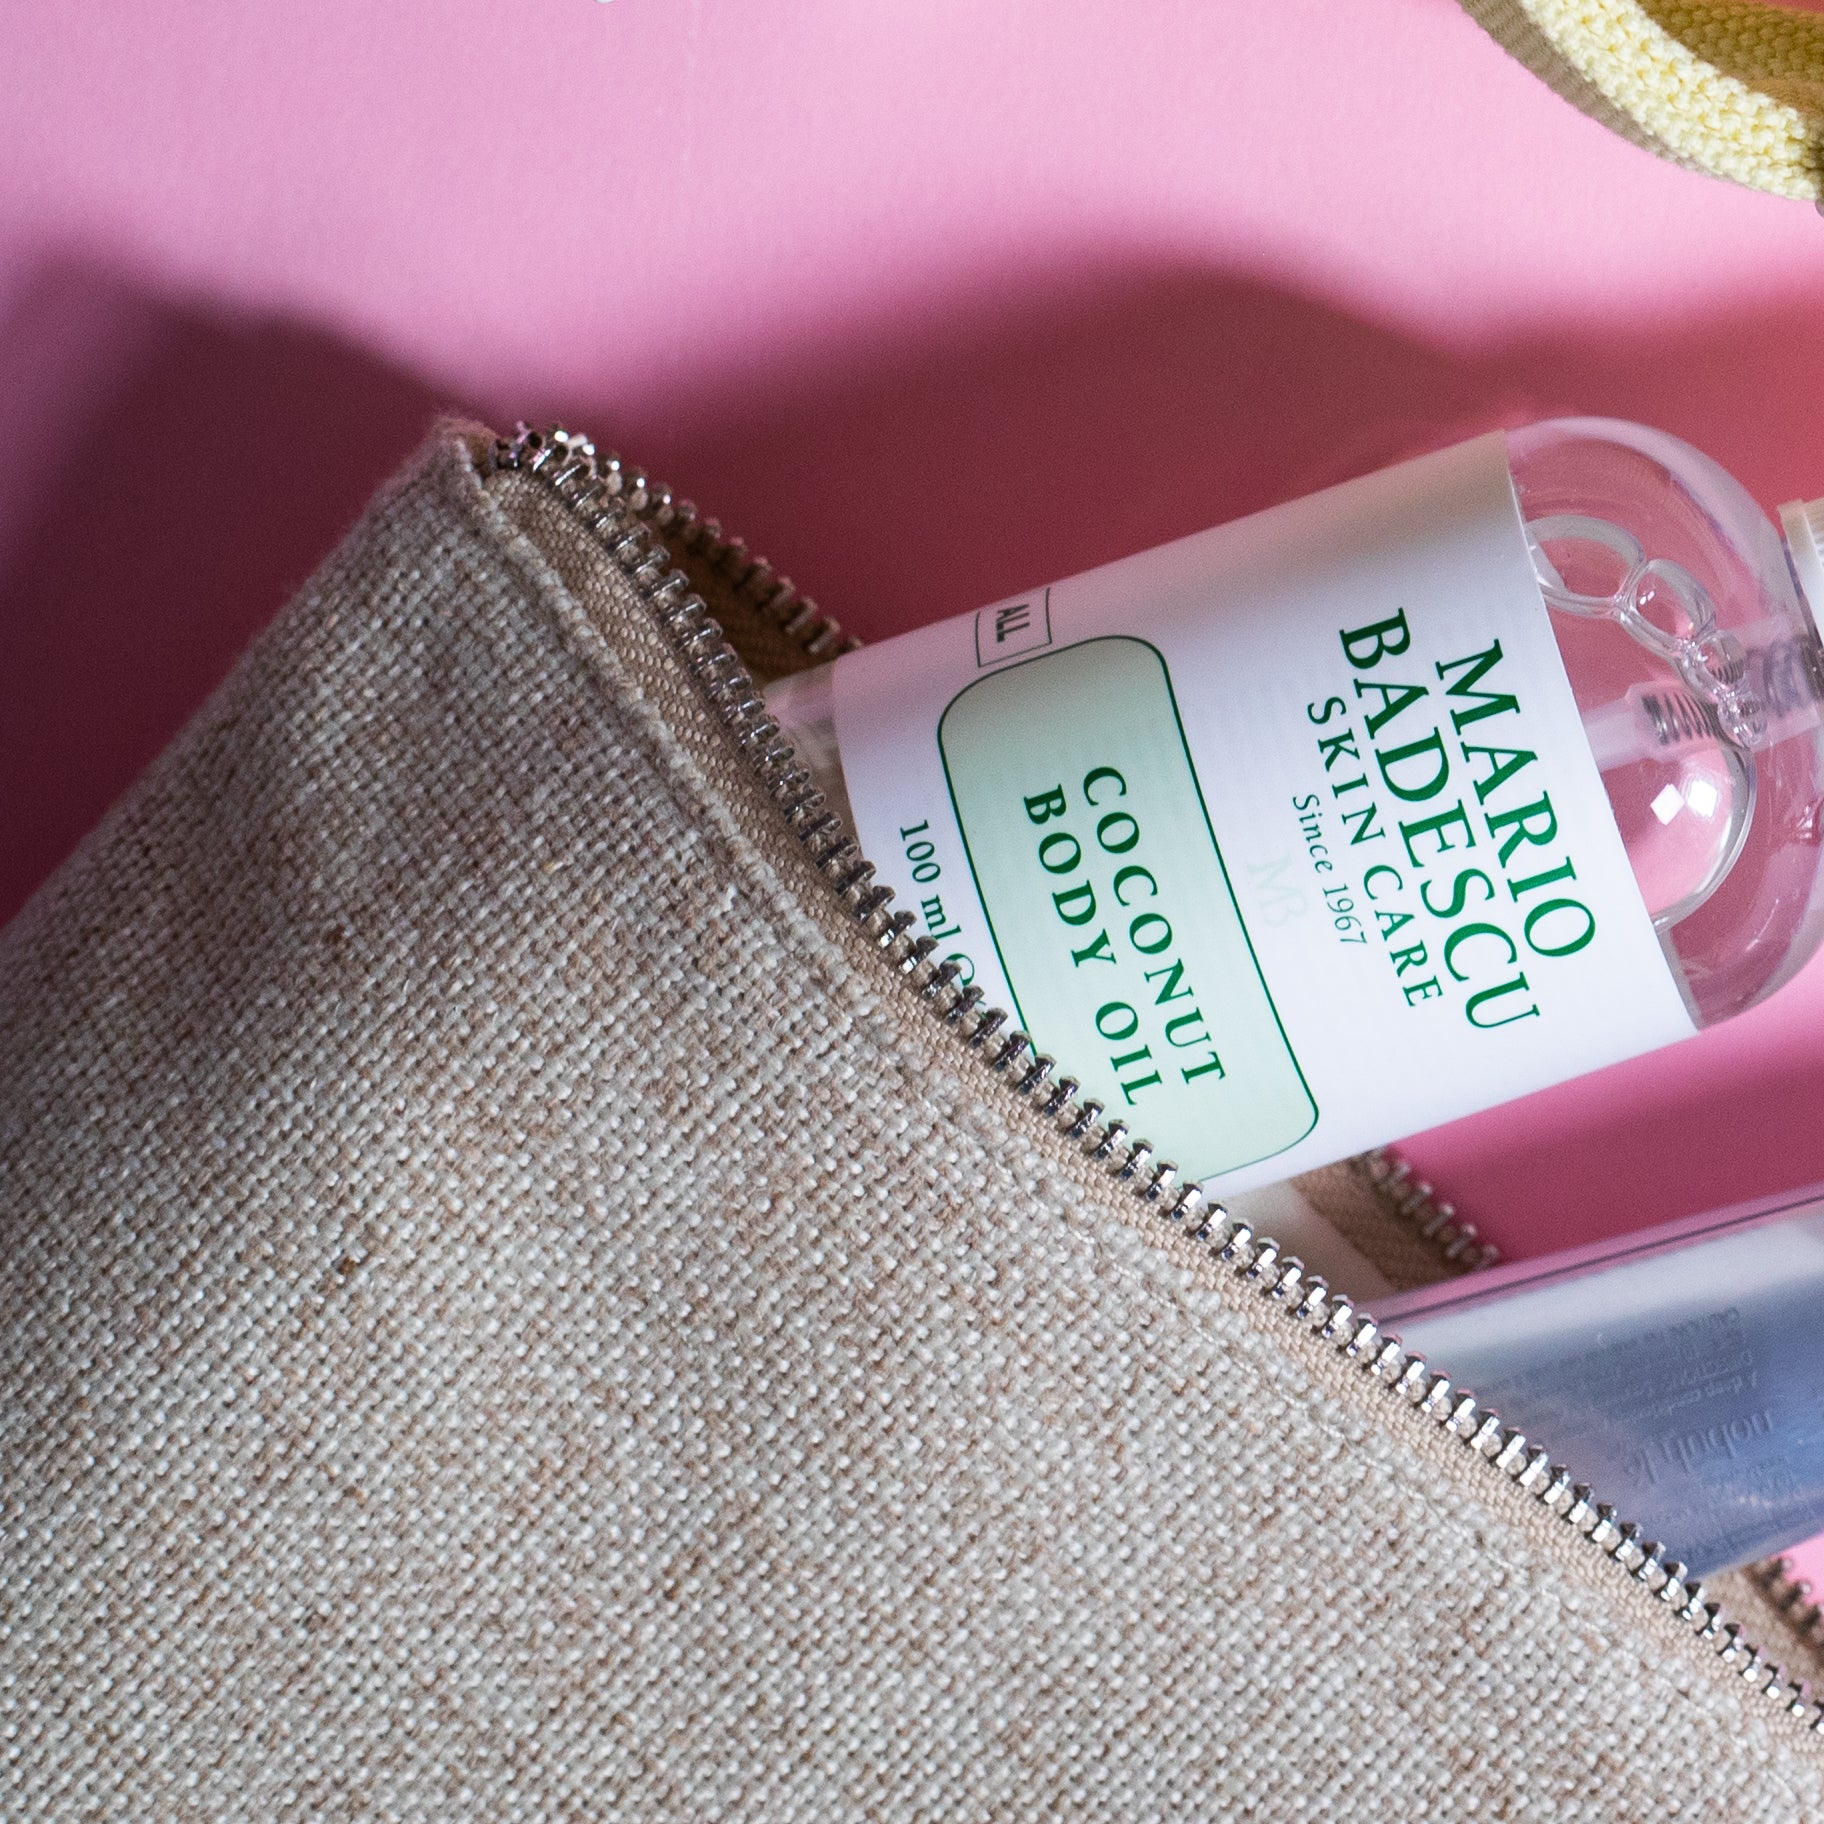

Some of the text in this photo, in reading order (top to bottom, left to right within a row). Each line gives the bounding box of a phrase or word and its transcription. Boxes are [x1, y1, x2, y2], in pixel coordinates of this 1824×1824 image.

[900, 820, 941, 883] 100
[921, 895, 961, 945] ml
[1023, 784, 1162, 1106] BODY OIL
[1083, 766, 1225, 1084] COCONUT
[1292, 794, 1367, 943] Since 1967
[1307, 696, 1443, 1007] SKIN CARE
[1338, 606, 1540, 1028] BADESCU
[1435, 638, 1595, 957] MARIO
